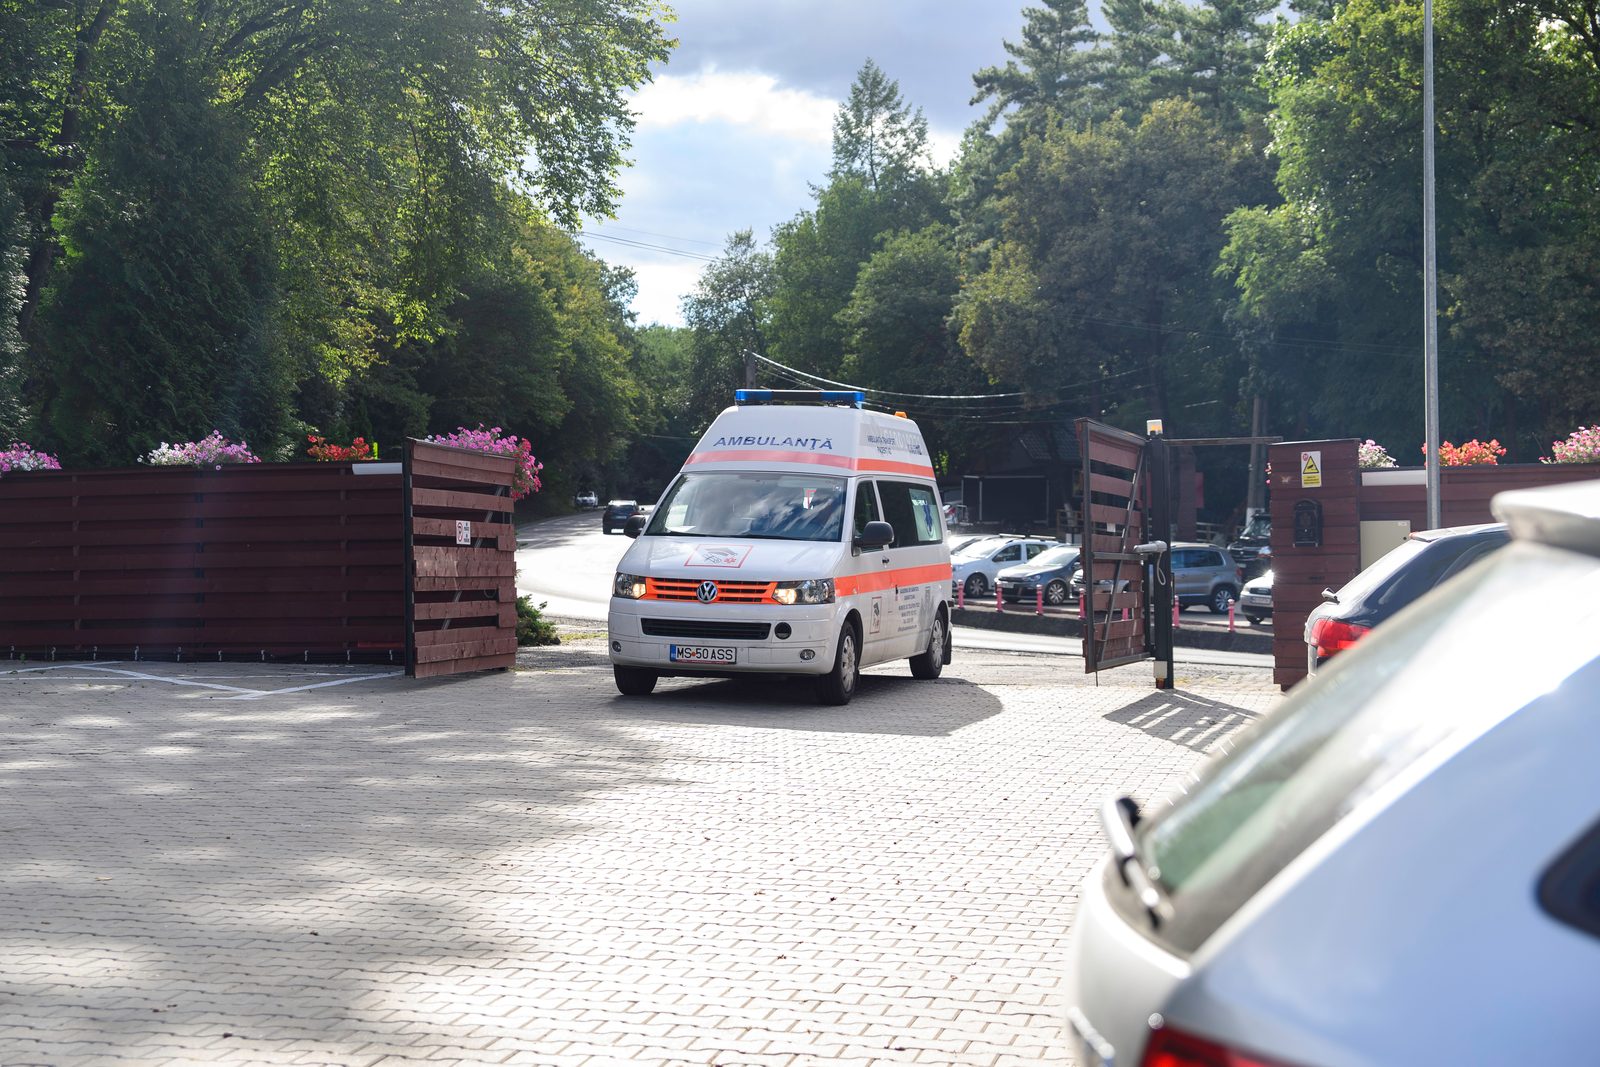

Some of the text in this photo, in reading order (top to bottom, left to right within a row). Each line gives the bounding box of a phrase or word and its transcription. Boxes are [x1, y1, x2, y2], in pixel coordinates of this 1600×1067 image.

[676, 647, 733, 661] MS 50 ASS
